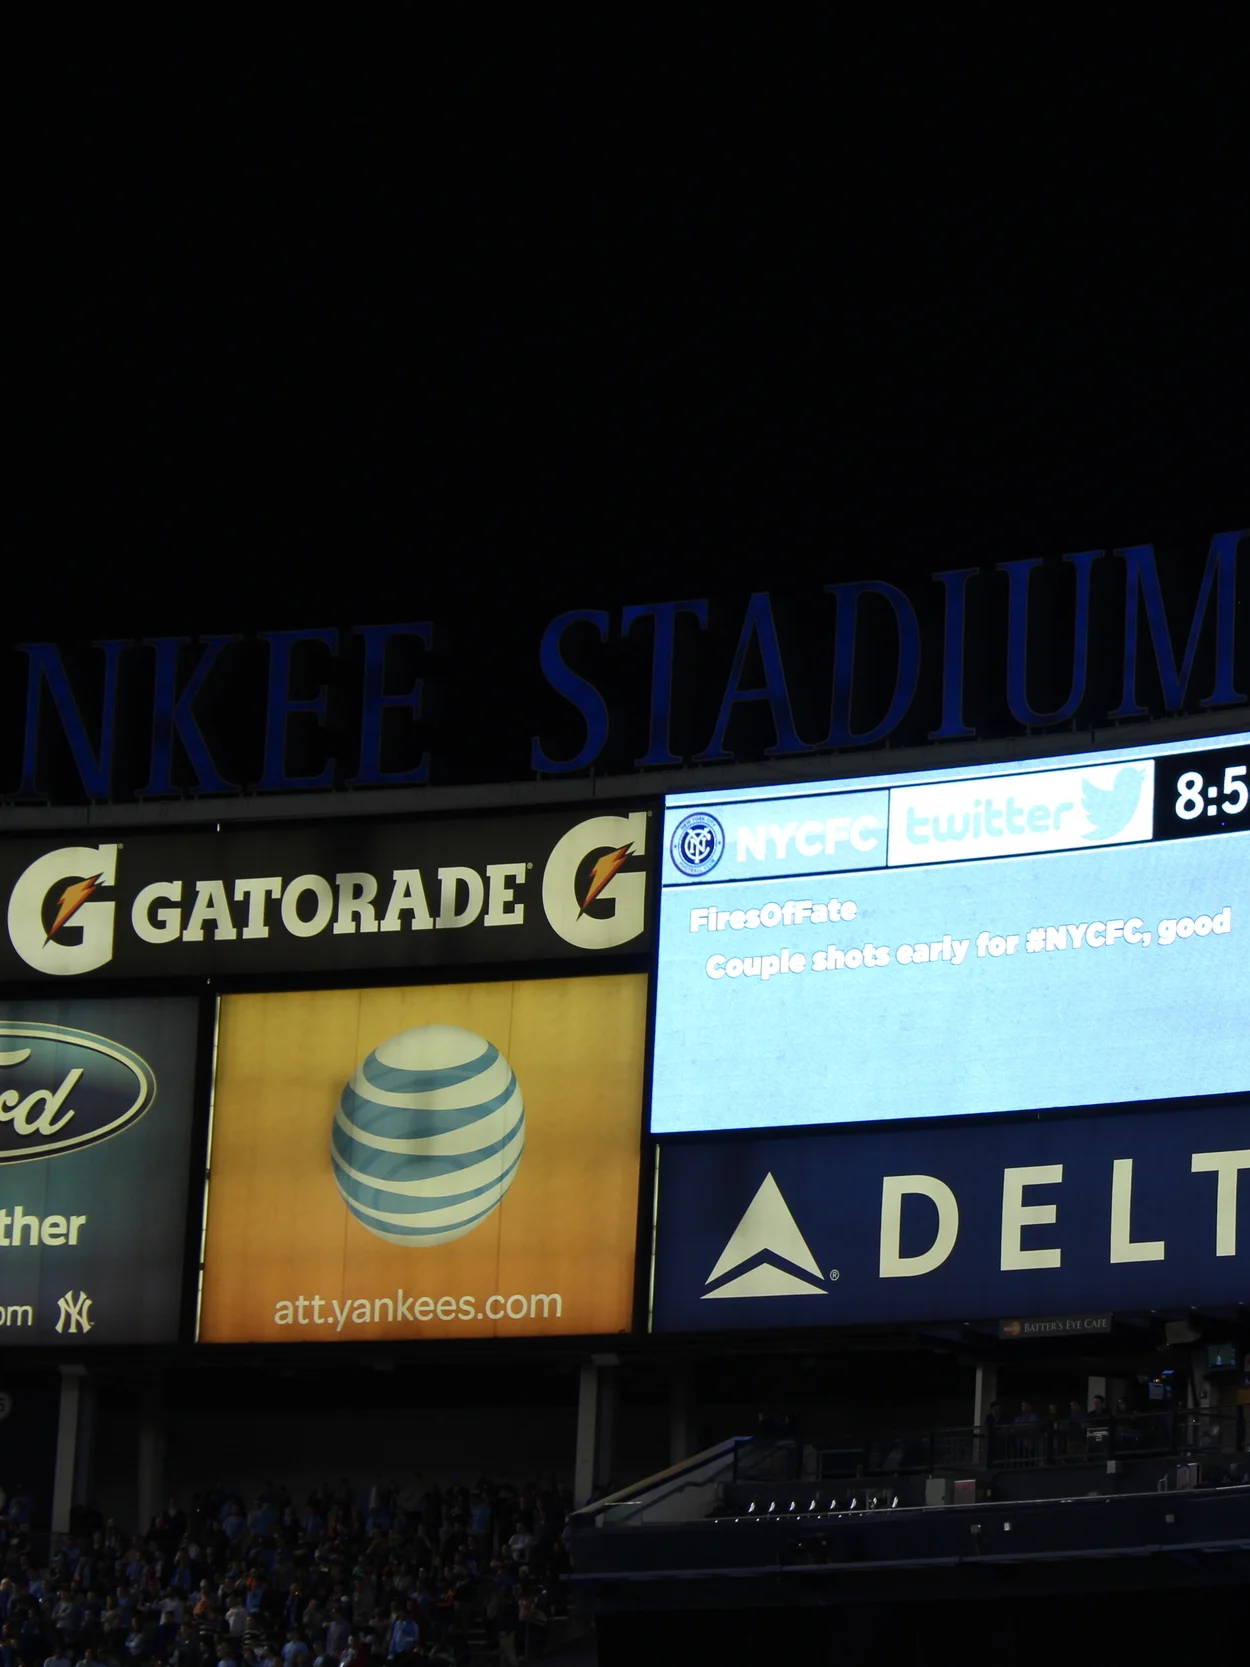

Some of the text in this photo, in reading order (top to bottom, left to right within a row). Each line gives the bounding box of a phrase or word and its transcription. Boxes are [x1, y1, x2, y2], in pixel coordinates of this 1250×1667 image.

[531, 528, 1250, 774] STADIUM
[736, 814, 880, 863] NYCFC
[905, 796, 1075, 846] twitter
[131, 862, 527, 945] GATORADE
[689, 898, 859, 934] FiresOfFate
[705, 906, 1233, 981] Couple shots early for #NYCFC, good
[273, 1289, 564, 1332] att.yankees.com
